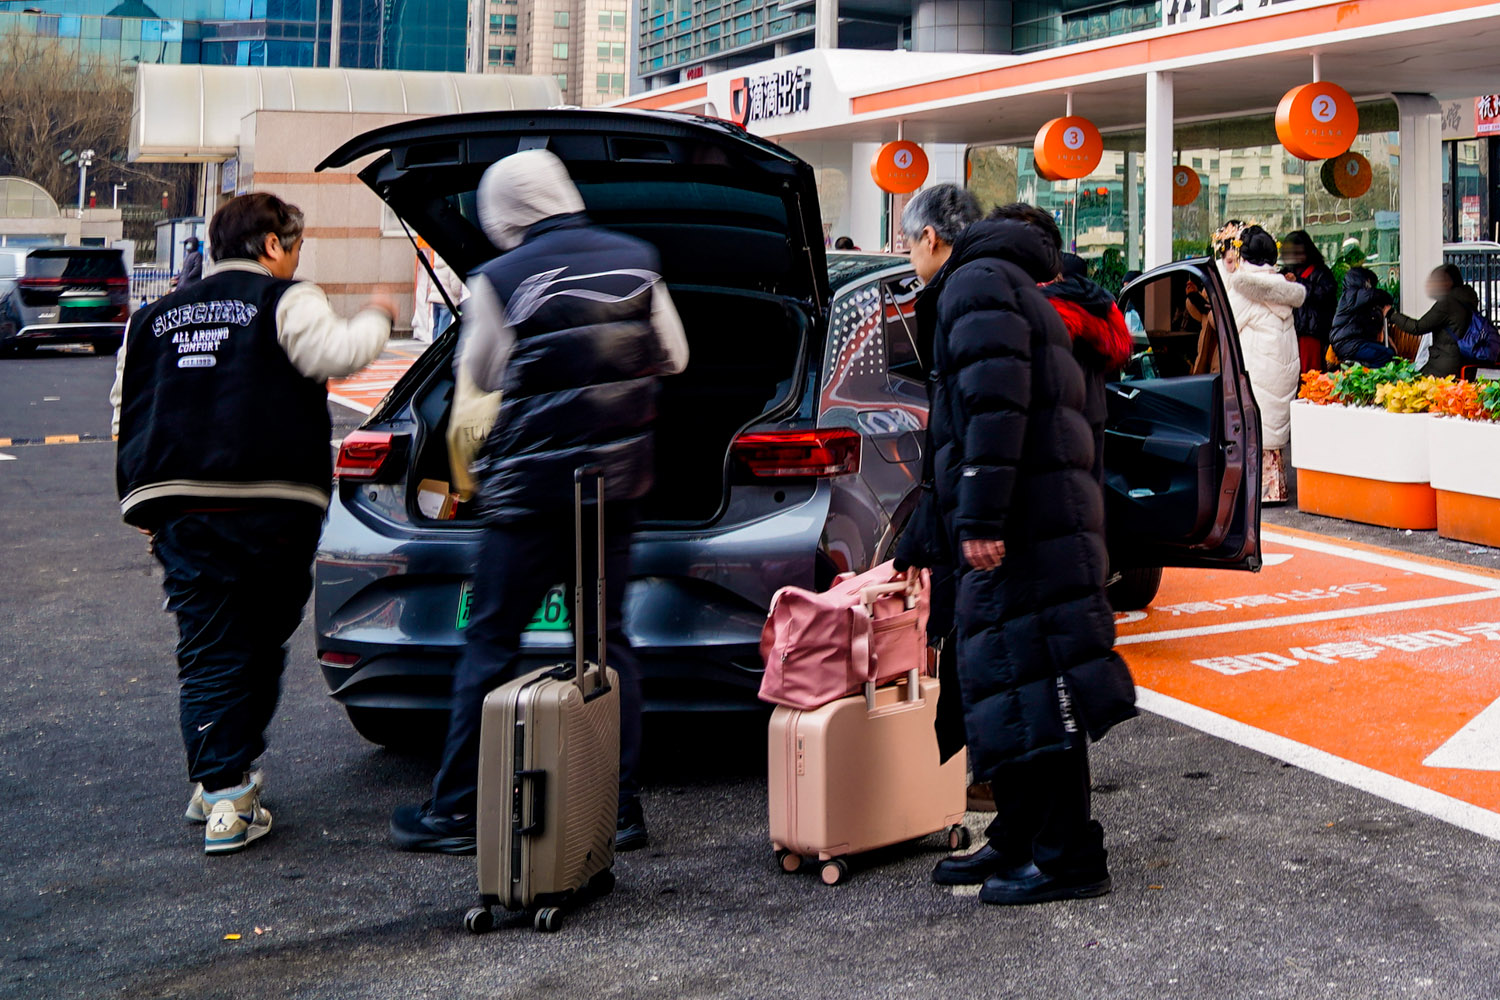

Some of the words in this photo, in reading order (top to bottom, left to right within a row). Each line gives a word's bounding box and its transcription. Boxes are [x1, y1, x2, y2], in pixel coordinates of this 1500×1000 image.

[749, 66, 811, 122] 滴滴出行
[1319, 100, 1329, 116] 2
[1069, 131, 1078, 145] 3
[898, 152, 908, 165] 4
[152, 299, 258, 338] SKECHERS
[172, 330, 190, 344] ALL
[192, 327, 230, 342] AROUND
[177, 340, 221, 353] COMFORT
[1157, 581, 1388, 617] 滴滴出行
